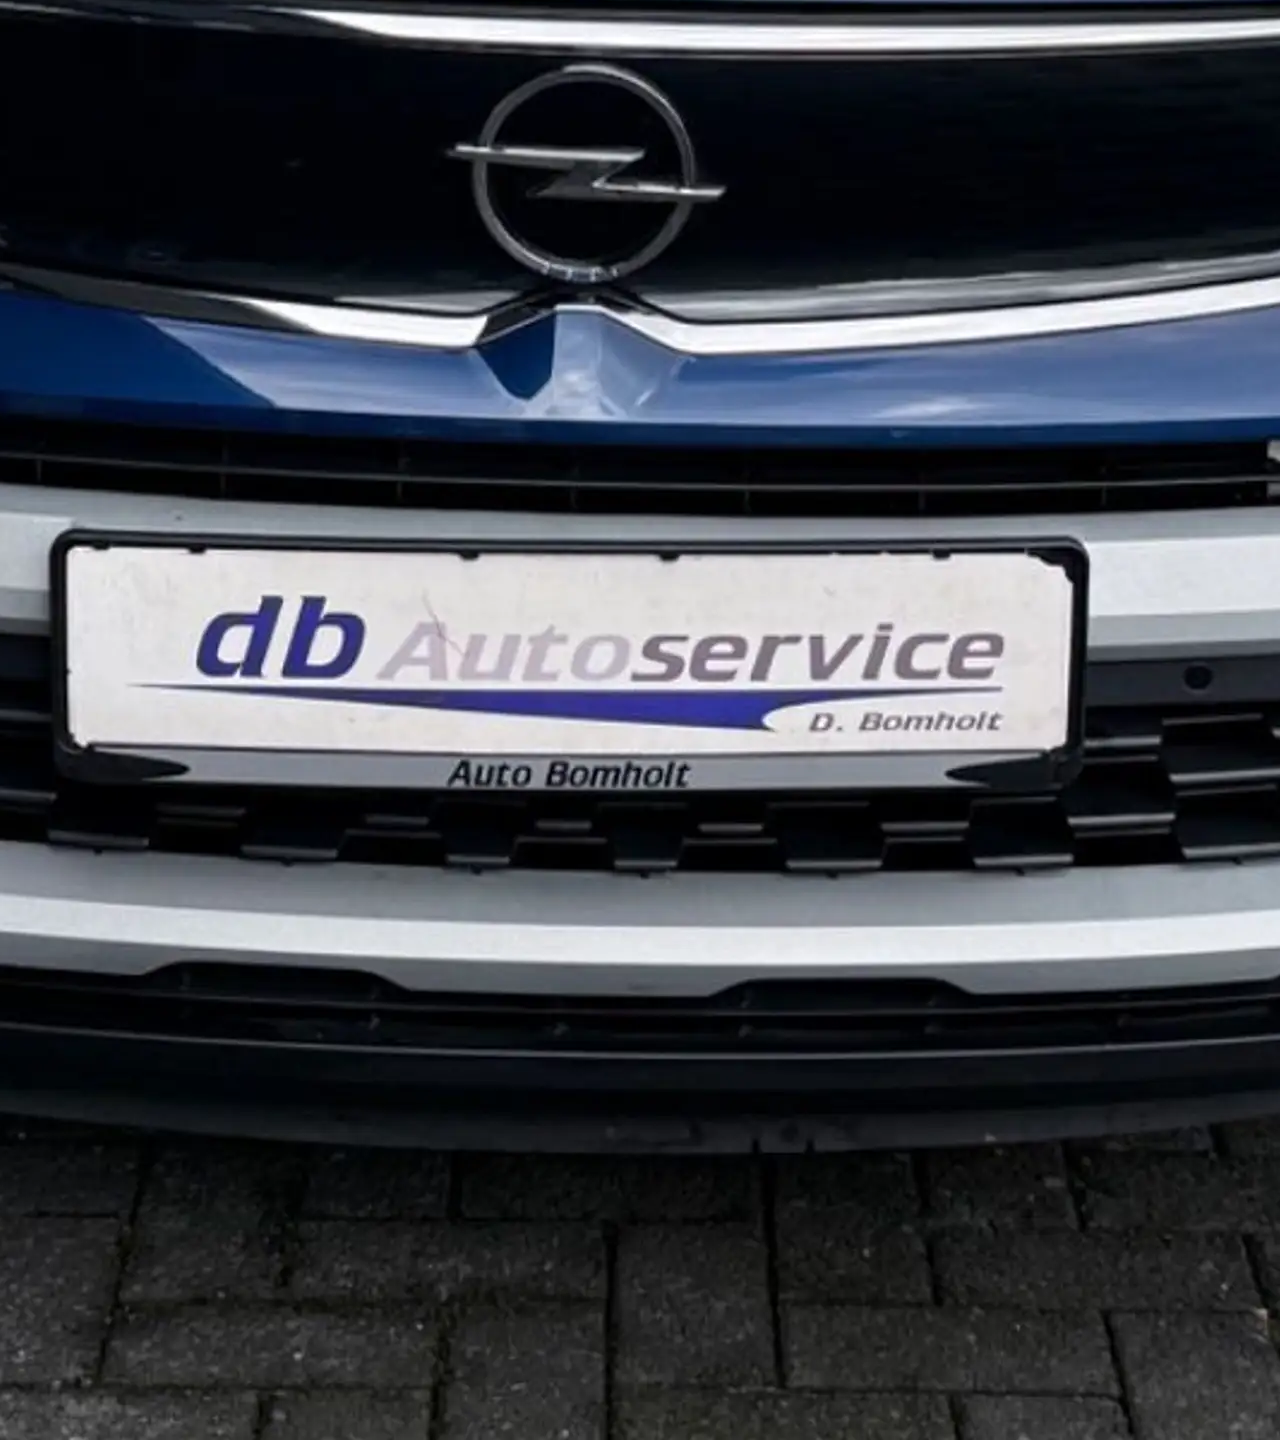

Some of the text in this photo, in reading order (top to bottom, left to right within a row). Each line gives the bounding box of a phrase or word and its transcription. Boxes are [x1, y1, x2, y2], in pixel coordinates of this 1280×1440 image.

[195, 594, 1005, 683] db Autoservice
[808, 711, 1003, 733] D. Bomholt
[446, 759, 692, 789] Auto Bomholt
